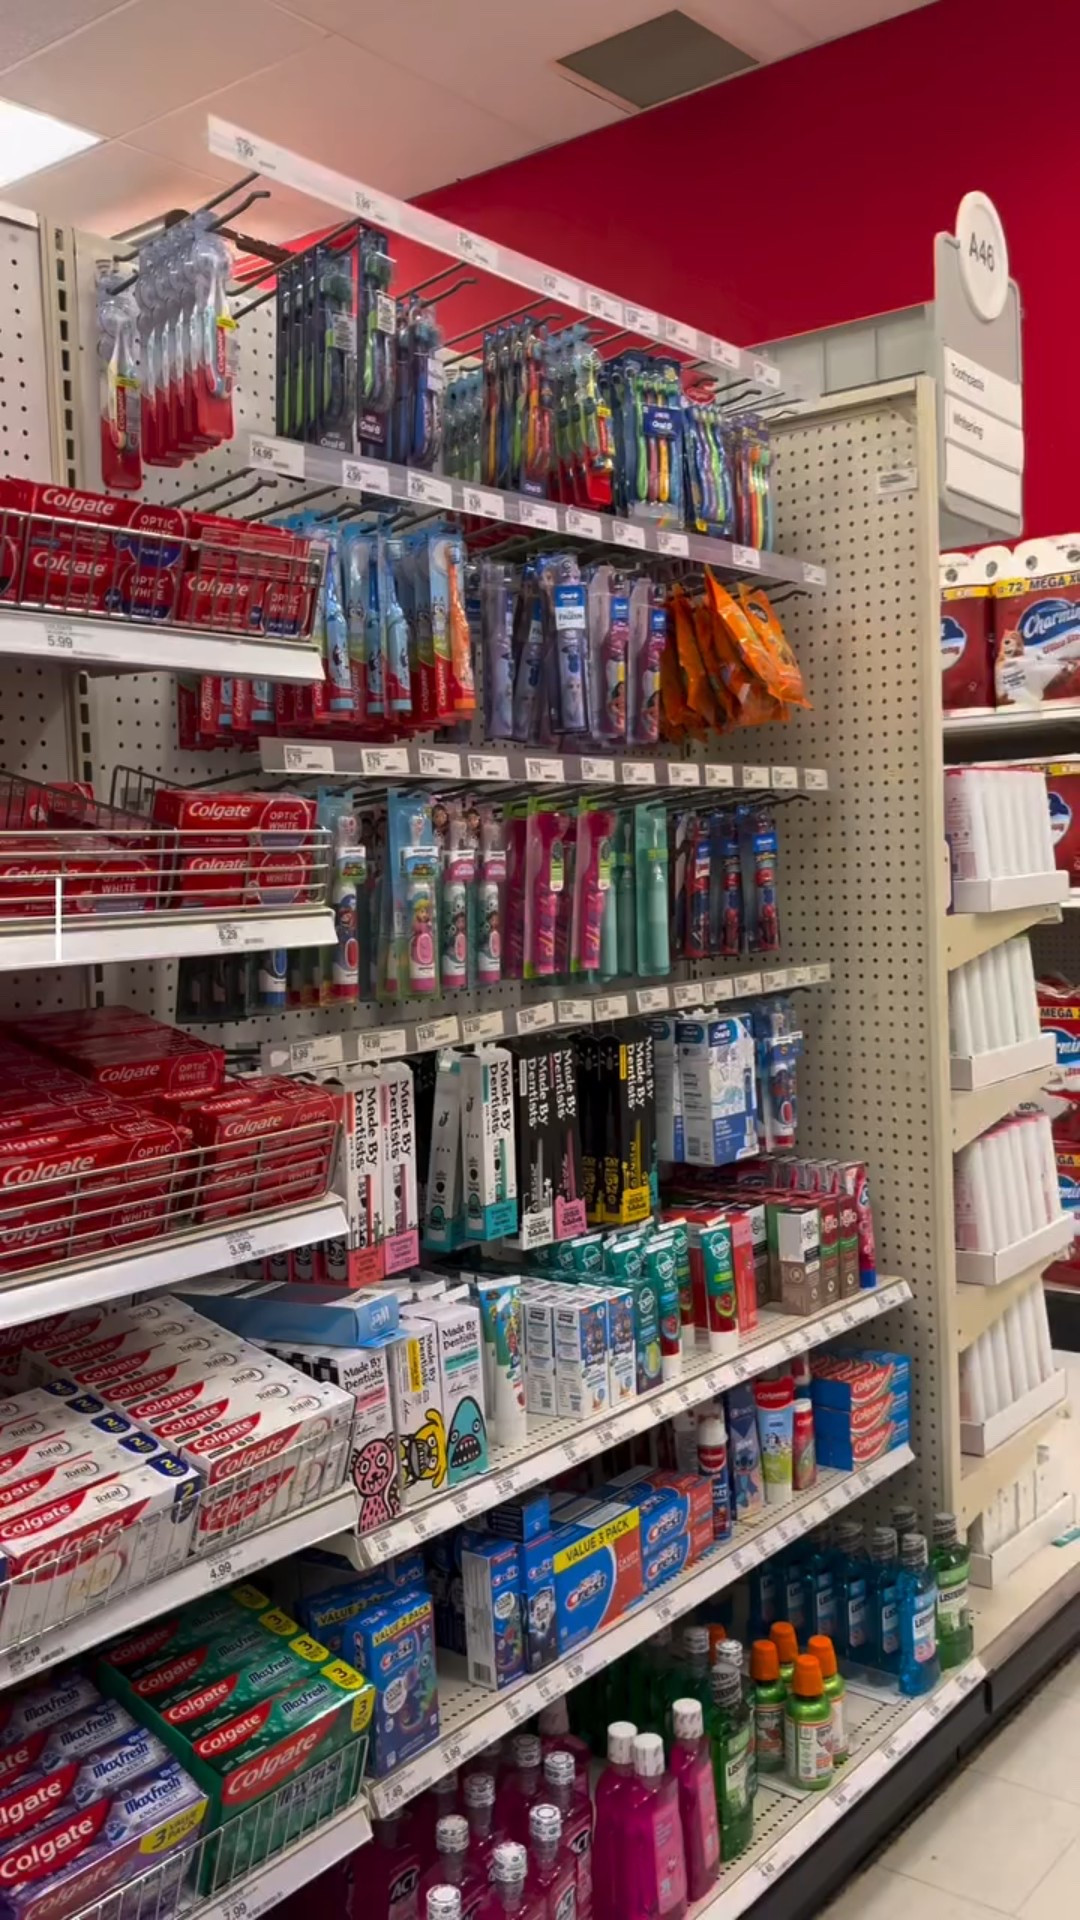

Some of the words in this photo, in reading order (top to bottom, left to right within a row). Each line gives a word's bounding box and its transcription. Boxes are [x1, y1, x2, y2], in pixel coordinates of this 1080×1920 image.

[969, 232, 995, 271] A46
[951, 363, 984, 392] Toothpaste
[953, 412, 984, 440] Whitening
[42, 488, 116, 516] Colgate
[140, 515, 174, 531] OPTIC
[33, 552, 107, 577] Colgate
[188, 576, 249, 598] Colgate
[1030, 576, 1066, 589] MEGA
[48, 635, 73, 649] 5.99
[189, 801, 250, 820] Colgate
[270, 811, 299, 820] OPTIC
[102, 883, 136, 893] WHITE
[100, 1064, 160, 1082] Colgate
[179, 1060, 208, 1072] OPTIC
[563, 1049, 576, 1092] Made
[636, 1042, 645, 1084] Made
[179, 1072, 206, 1082] WHITE
[500, 1061, 510, 1106] Made
[538, 1055, 550, 1100] Made
[553, 1052, 566, 1118] Dentists
[627, 1044, 637, 1109] Dentists
[400, 1079, 414, 1128] Made
[489, 1064, 498, 1133] Dentists
[528, 1059, 539, 1127] Dentists
[636, 1086, 645, 1107] By
[366, 1087, 379, 1138] Made
[538, 1103, 549, 1126] By
[566, 1095, 576, 1117] By
[225, 1115, 283, 1138] Colgate
[354, 1091, 362, 1169] Dentists
[500, 1110, 511, 1133] By
[138, 1145, 171, 1158] OPTIC
[366, 1144, 377, 1166] By
[400, 1133, 411, 1156] By
[3, 1155, 95, 1186] Colgate
[442, 1324, 465, 1339] Made
[466, 1321, 476, 1330] By
[444, 1333, 478, 1350] Dentists
[83, 1357, 142, 1382] Colgate
[203, 1354, 230, 1369] Total
[343, 1360, 369, 1378] Made
[370, 1357, 382, 1370] By
[109, 1372, 168, 1398] Colgate
[231, 1369, 256, 1385] Total
[345, 1369, 384, 1390] Dentists
[136, 1388, 195, 1414] Colgate
[256, 1384, 282, 1400] Total
[288, 1398, 314, 1414] Total
[161, 1405, 220, 1432] Colgate
[194, 1420, 252, 1449] Colgate
[36, 1443, 64, 1458] Total
[216, 1436, 284, 1477] Colgate
[64, 1463, 92, 1479] Total
[161, 1459, 176, 1470] 2
[0, 1479, 40, 1500] gate
[95, 1486, 122, 1502] Total
[182, 1483, 195, 1498] 2
[1, 1503, 72, 1538] Colgate
[648, 1506, 683, 1543] Crest
[565, 1538, 596, 1562] VALUE
[598, 1532, 606, 1545] 3
[606, 1519, 630, 1539] PACK
[208, 1560, 232, 1580] 4.99
[648, 1543, 683, 1580] Crest
[565, 1570, 607, 1612] Crest
[298, 1640, 313, 1651] 3
[380, 1637, 413, 1671] Crest
[138, 1657, 197, 1692] Colgate
[332, 1668, 348, 1679] 3
[168, 1683, 229, 1720] Colgate
[200, 1714, 261, 1753] Colgate
[228, 1732, 318, 1795] Colgate
[0, 1781, 62, 1825] lgate
[1, 1818, 94, 1878] Colgate
[152, 1829, 167, 1850] 3
